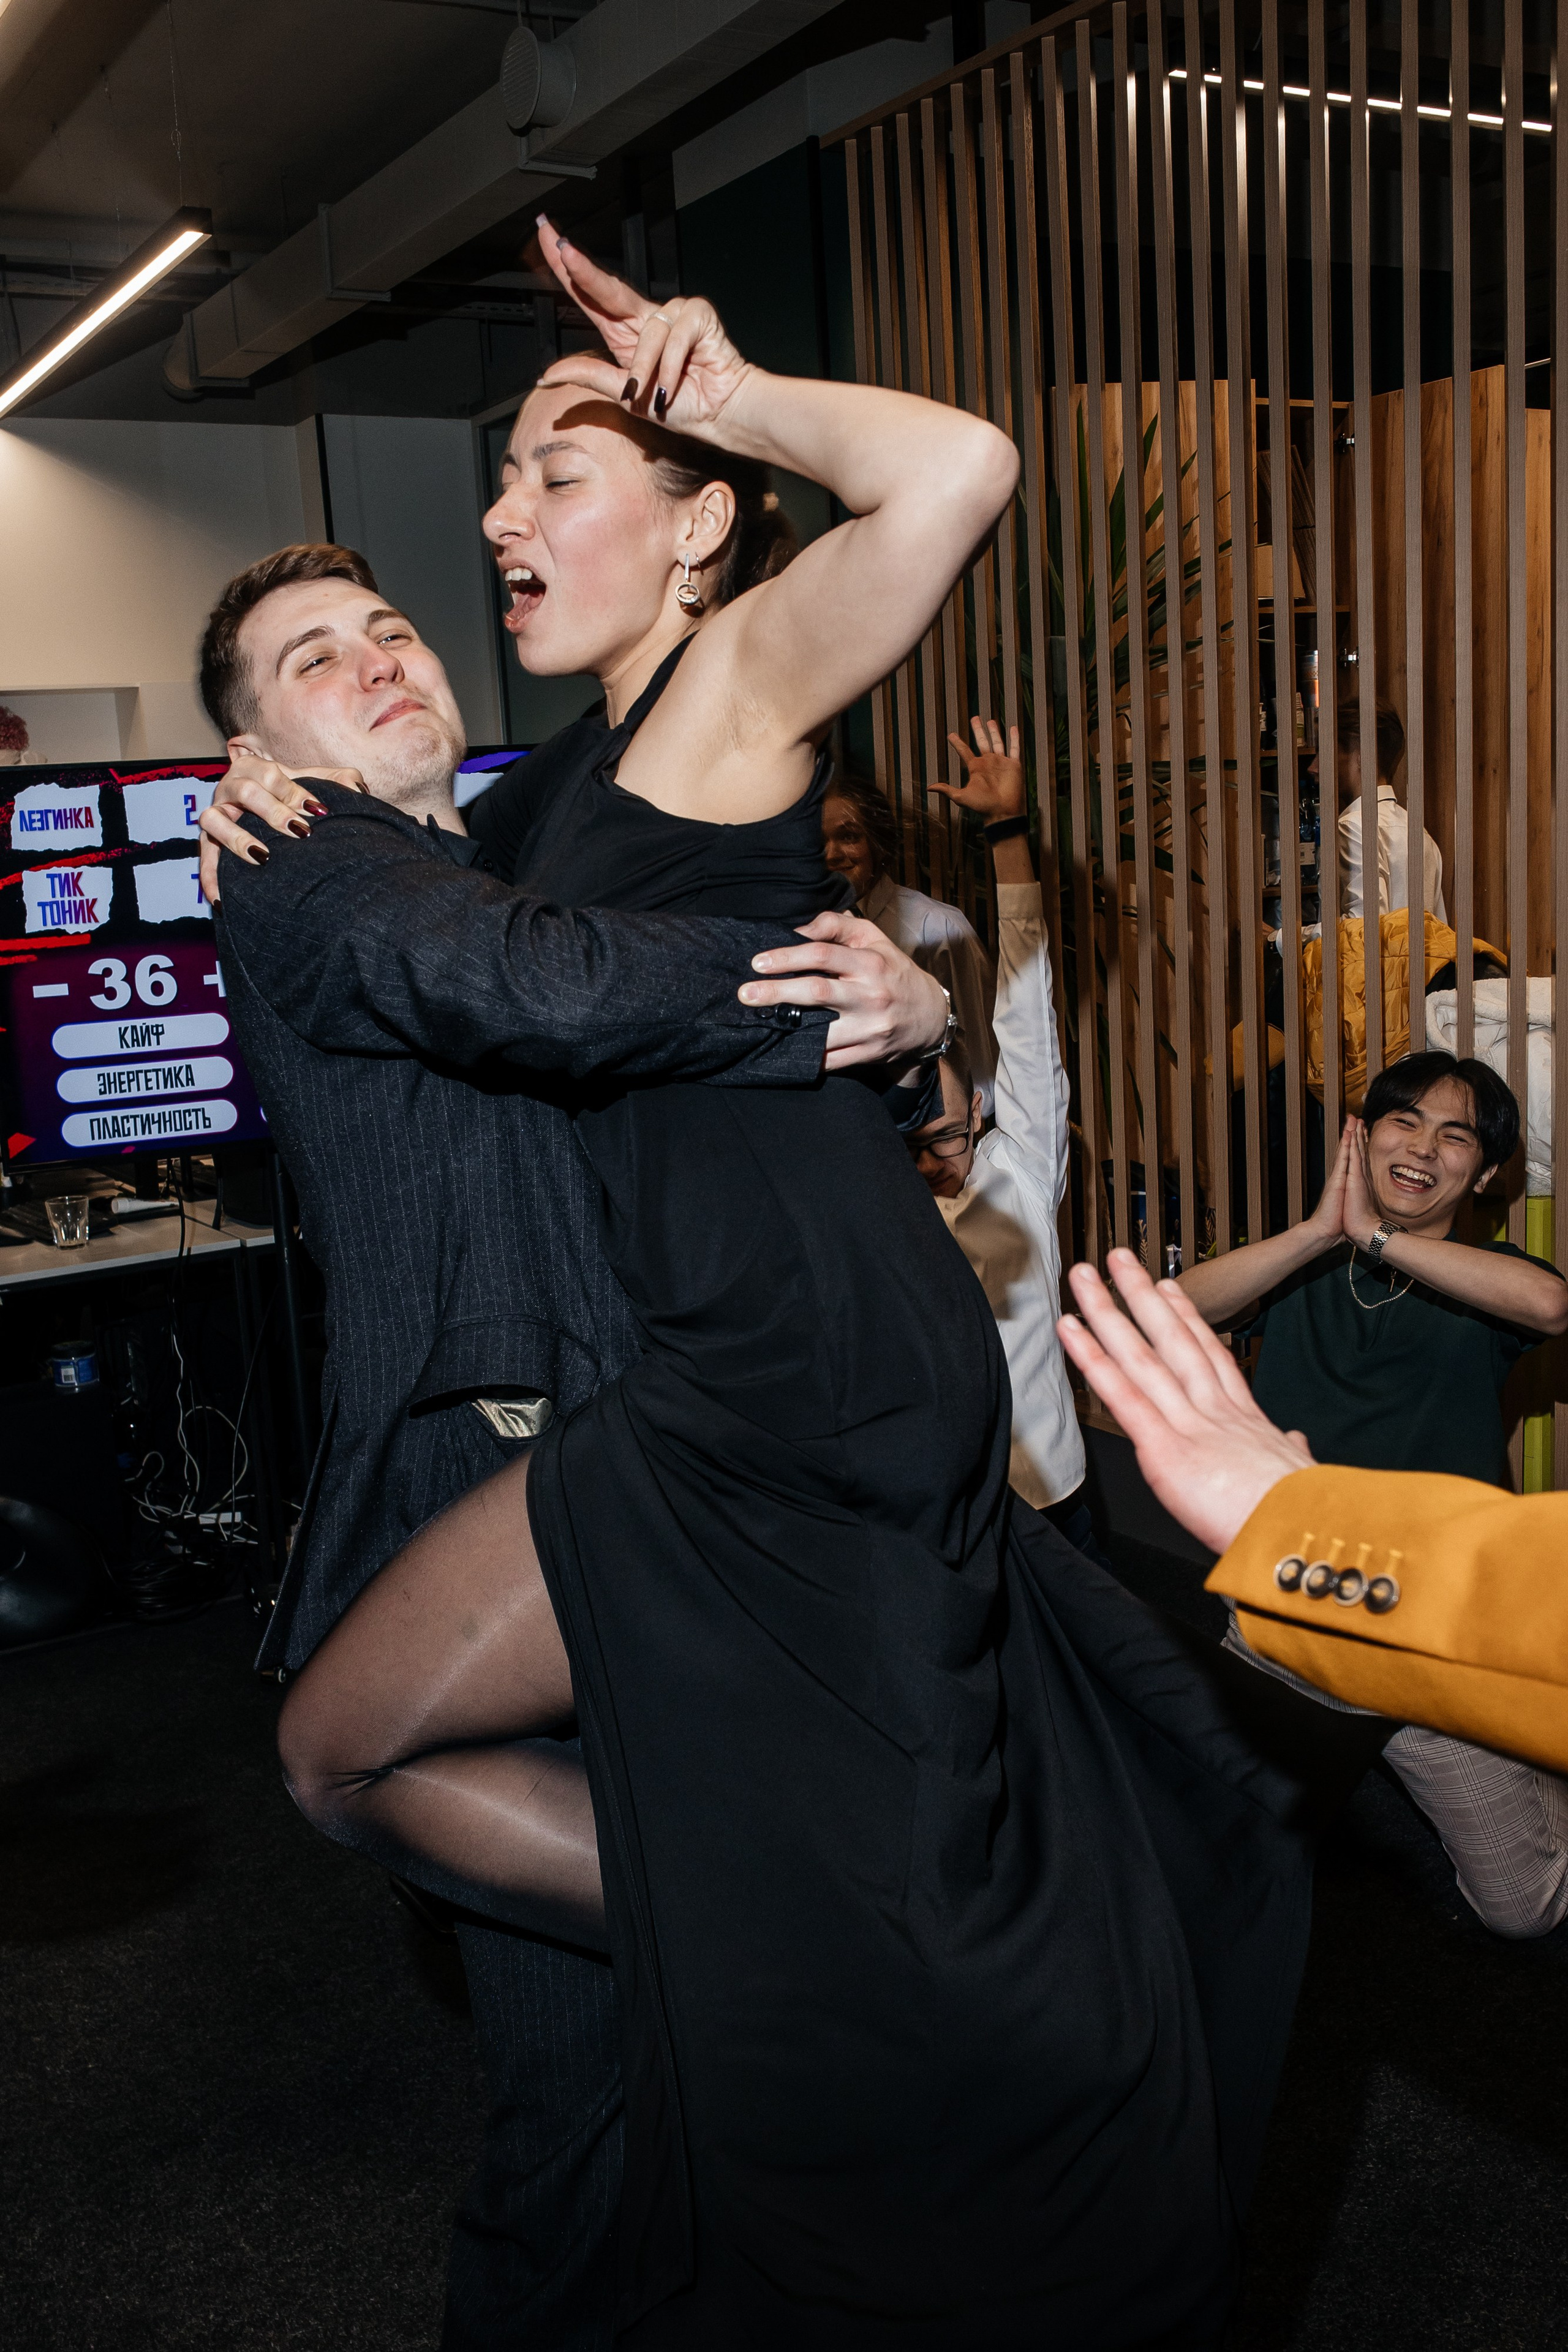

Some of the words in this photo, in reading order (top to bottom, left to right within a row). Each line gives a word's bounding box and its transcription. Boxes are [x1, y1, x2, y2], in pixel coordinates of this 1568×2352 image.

[19, 806, 94, 832] ЛЕЗГИНКА
[46, 871, 85, 898] ТИК
[37, 897, 99, 926] ТОНИК
[88, 954, 178, 1010] 36
[118, 1022, 165, 1049] КАЙФ
[97, 1064, 195, 1096] ЭНЕРГЕТИКА
[89, 1107, 211, 1140] ПЛАСТИЧНОСТЬ
